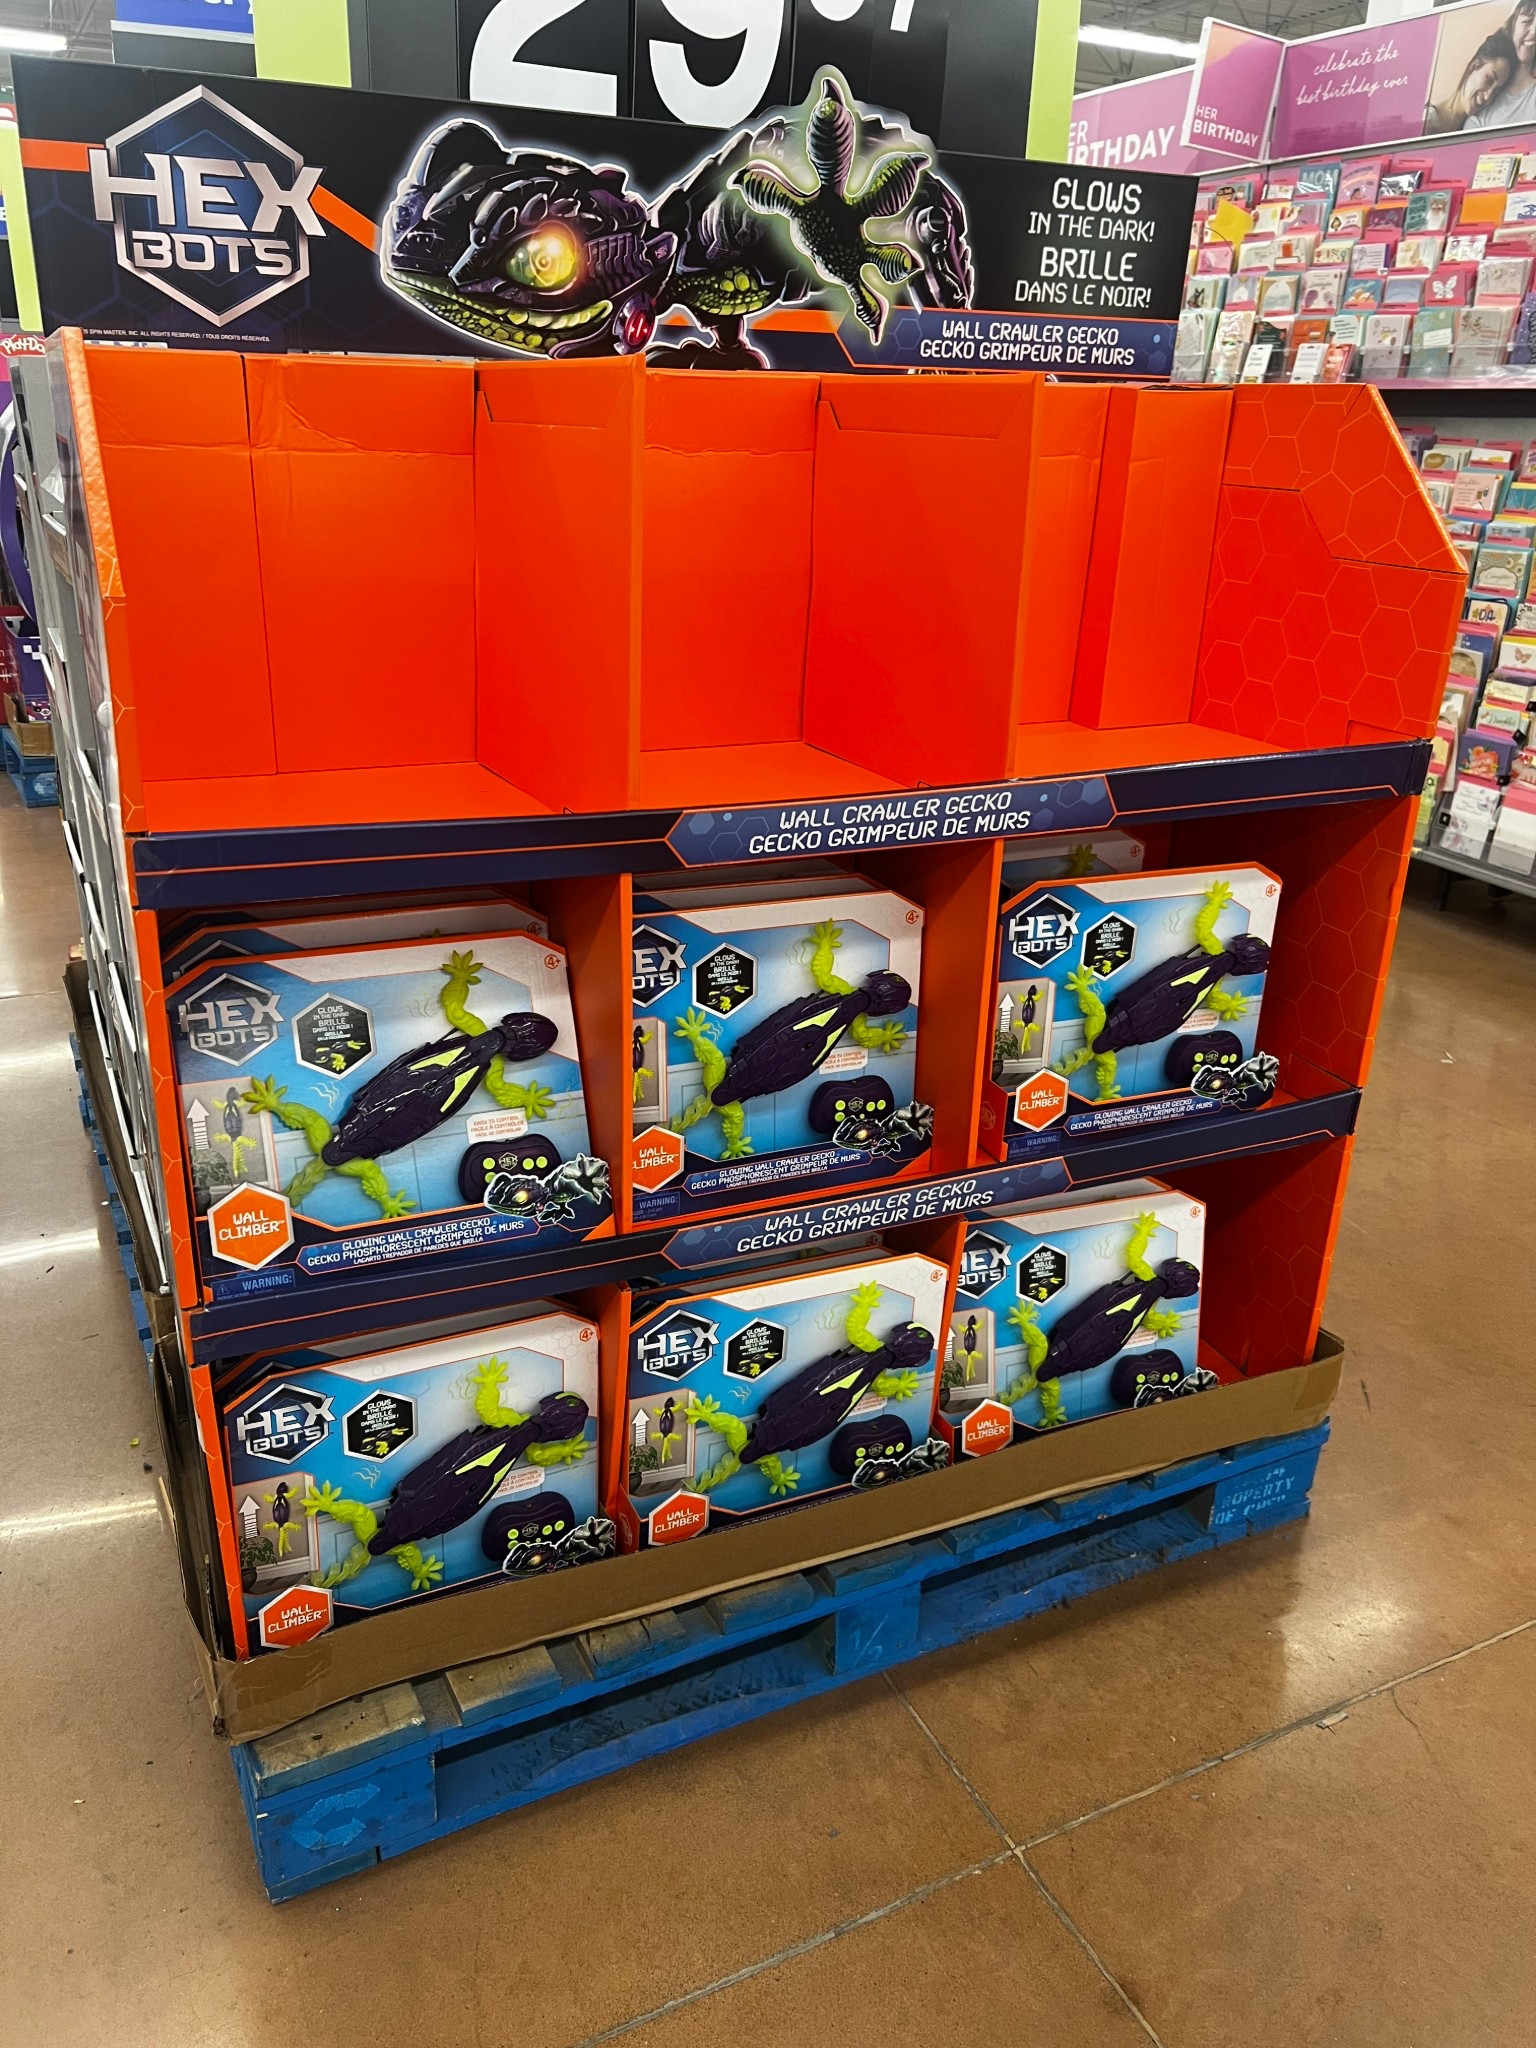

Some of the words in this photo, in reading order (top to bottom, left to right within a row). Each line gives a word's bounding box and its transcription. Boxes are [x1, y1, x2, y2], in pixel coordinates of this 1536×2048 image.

[1314, 47, 1371, 75] celebrate
[1373, 40, 1399, 63] the
[1296, 85, 1322, 105] best
[1322, 75, 1380, 100] birthday
[1383, 76, 1408, 88] ever
[1196, 105, 1218, 121] HER
[1067, 125, 1175, 167] IRTHDAY
[1068, 121, 1088, 146] ER
[1193, 120, 1259, 147] BIRTHDAY
[88, 148, 327, 237] HEX
[1052, 178, 1142, 214] GLOWS
[1028, 212, 1051, 234] IN
[1058, 214, 1095, 238] THE
[1099, 218, 1155, 242] DARK!
[133, 231, 293, 275] BOTS
[1040, 246, 1137, 282] BRILLE
[1015, 280, 1068, 303] DANS
[1073, 283, 1096, 305] LE
[1100, 285, 1151, 308] NOIR!
[943, 320, 983, 340] WALL
[990, 322, 1062, 343] CRAWLER
[1068, 326, 1119, 345] GECKO
[0, 337, 46, 355] Play-Do
[920, 339, 974, 359] GECKO
[979, 342, 1061, 363] GRIMPEUR
[1066, 347, 1088, 363] DE
[1091, 348, 1135, 366] MURS
[780, 809, 835, 830] WALL
[843, 800, 940, 824] CRAWLER
[946, 792, 1012, 815] GECKO
[749, 831, 822, 854] GECKO
[828, 821, 934, 848] GRIMPEUR
[943, 819, 969, 836] DE
[974, 811, 1030, 833] MURS
[1009, 913, 1081, 941] HEX
[633, 944, 687, 973] EX
[1018, 937, 1067, 954] BOTS
[632, 972, 674, 989] OTS
[714, 965, 736, 973] BRILLE
[178, 994, 284, 1032] HEX
[318, 1018, 346, 1027] BRILLE
[198, 1026, 270, 1048] BOTS
[1031, 1089, 1054, 1099] WALL
[1071, 1122, 1091, 1130] GECKO
[1093, 1112, 1152, 1126] PHOSPHORESCENT
[1154, 1106, 1185, 1116] GRIMPEUR
[1095, 1111, 1123, 1119] GLOWING
[1125, 1107, 1140, 1115] WALL
[1142, 1103, 1170, 1113] CRAWLER
[1172, 1099, 1192, 1108] GECKO
[633, 1155, 674, 1169] LIMBER
[640, 1146, 667, 1158] WALL
[719, 1166, 753, 1177] GLOWING
[755, 1162, 774, 1171] WALL
[776, 1157, 809, 1167] CRAWLER
[812, 1151, 835, 1161] GECKO
[692, 1180, 716, 1190] GECKO
[719, 1167, 788, 1184] PHOSPHORESCENT
[790, 1159, 827, 1171] GRIMPEUR
[841, 1153, 861, 1163] MURS
[639, 1196, 678, 1209] WARNING:
[765, 1212, 812, 1232] WALL
[822, 1192, 910, 1222] CRAWLER
[916, 1179, 977, 1204] GECKO
[233, 1209, 269, 1225] WALL
[737, 1229, 803, 1252] GECKO
[808, 1208, 908, 1239] GRIMPEUR
[913, 1203, 937, 1219] DE
[943, 1191, 994, 1212] MURS
[308, 1254, 340, 1266] GECKO
[343, 1238, 432, 1260] PHOSPHORESCENT
[434, 1228, 482, 1243] GRIMPEUR
[485, 1225, 497, 1234] DE
[499, 1221, 524, 1232] MURS
[343, 1236, 385, 1250] GLOWING
[388, 1232, 412, 1242] WALL
[415, 1223, 457, 1237] CRAWLER
[460, 1218, 490, 1230] GECKO
[354, 1254, 381, 1264] LAGARTO
[414, 1247, 422, 1255] DE
[463, 1237, 483, 1246] BRILLA
[242, 1274, 292, 1290] WARNING:
[638, 1323, 720, 1360] HEX
[649, 1348, 706, 1371] BOTS
[237, 1397, 336, 1440] HEX
[367, 1409, 392, 1420] BRILLE
[977, 1418, 1000, 1430] WALL
[253, 1426, 321, 1452] BOTS
[667, 1508, 693, 1521] WALL
[282, 1604, 313, 1619] WALL
